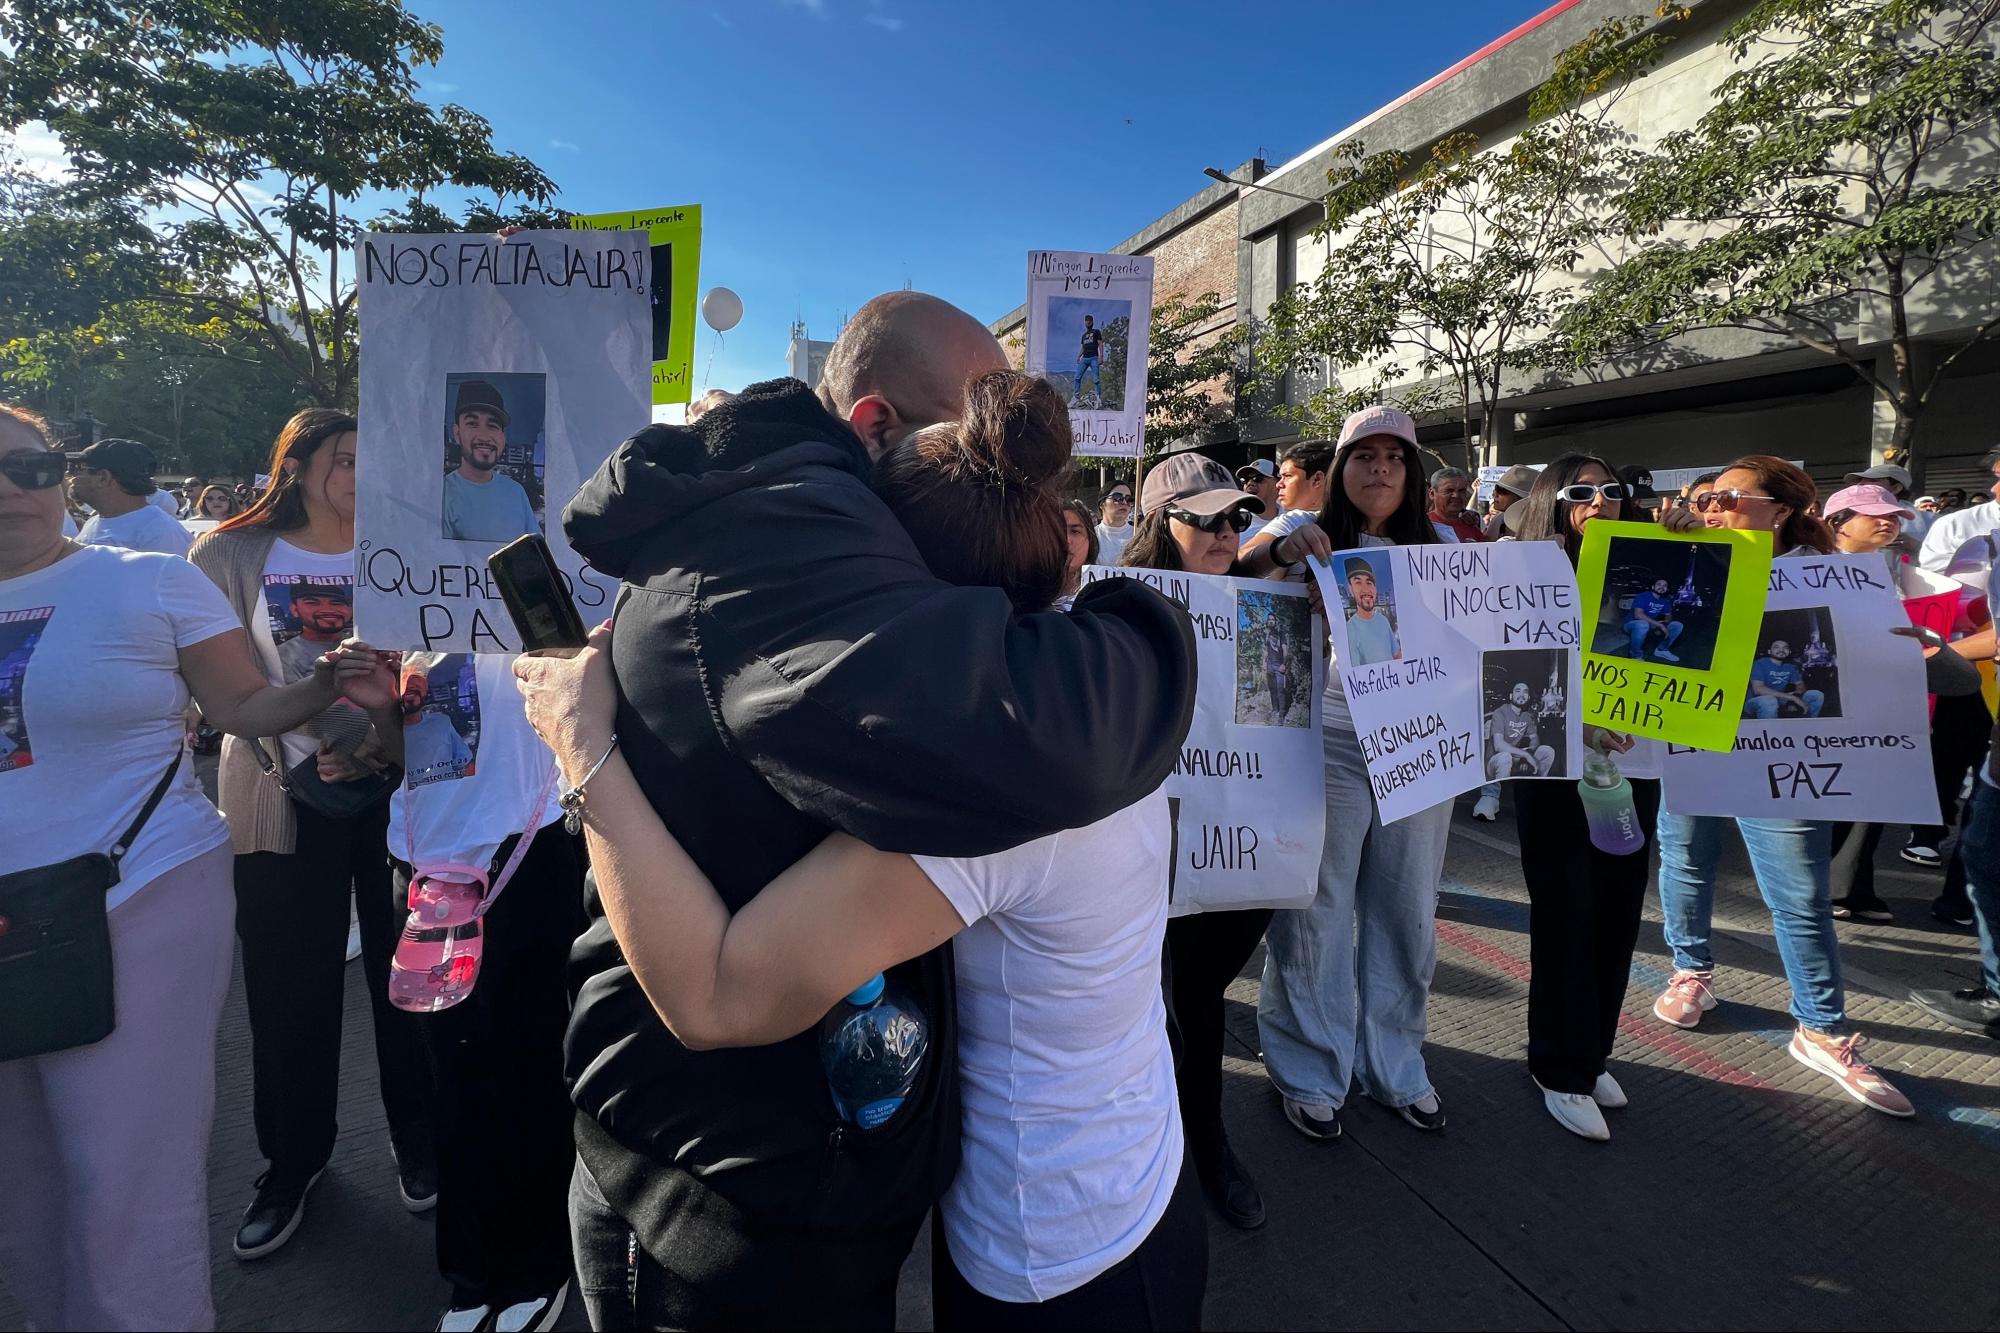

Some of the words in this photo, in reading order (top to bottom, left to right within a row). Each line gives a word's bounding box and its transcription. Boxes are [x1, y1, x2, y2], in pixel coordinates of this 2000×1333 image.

[365, 241, 449, 287] NOS
[458, 242, 545, 286] FALTA
[547, 243, 645, 294] JAIR!
[1364, 411, 1398, 428] LA
[356, 539, 607, 607] ¡QUERES
[1407, 547, 1490, 585] NINGUN
[1802, 564, 1886, 591] JAIR
[1444, 583, 1572, 621] INOCENTE
[419, 604, 527, 652] PA
[1189, 612, 1233, 641] MAS!
[1403, 656, 1447, 685] JAIR
[1583, 659, 1628, 689] NOS
[1643, 671, 1724, 712] FALTA
[1590, 692, 1663, 730] JAIR
[1359, 736, 1382, 765] EN
[1383, 713, 1447, 752] SINALOA
[1729, 729, 1796, 752] inaloa
[1804, 733, 1916, 752] queremos
[1173, 748, 1263, 779] NALOA!!
[1372, 749, 1436, 801] QUEREMOS
[1438, 732, 1475, 771] PAZ
[1768, 761, 1852, 799] PAZ
[1616, 807, 1635, 841] Sport
[1191, 824, 1258, 870] JAIR
